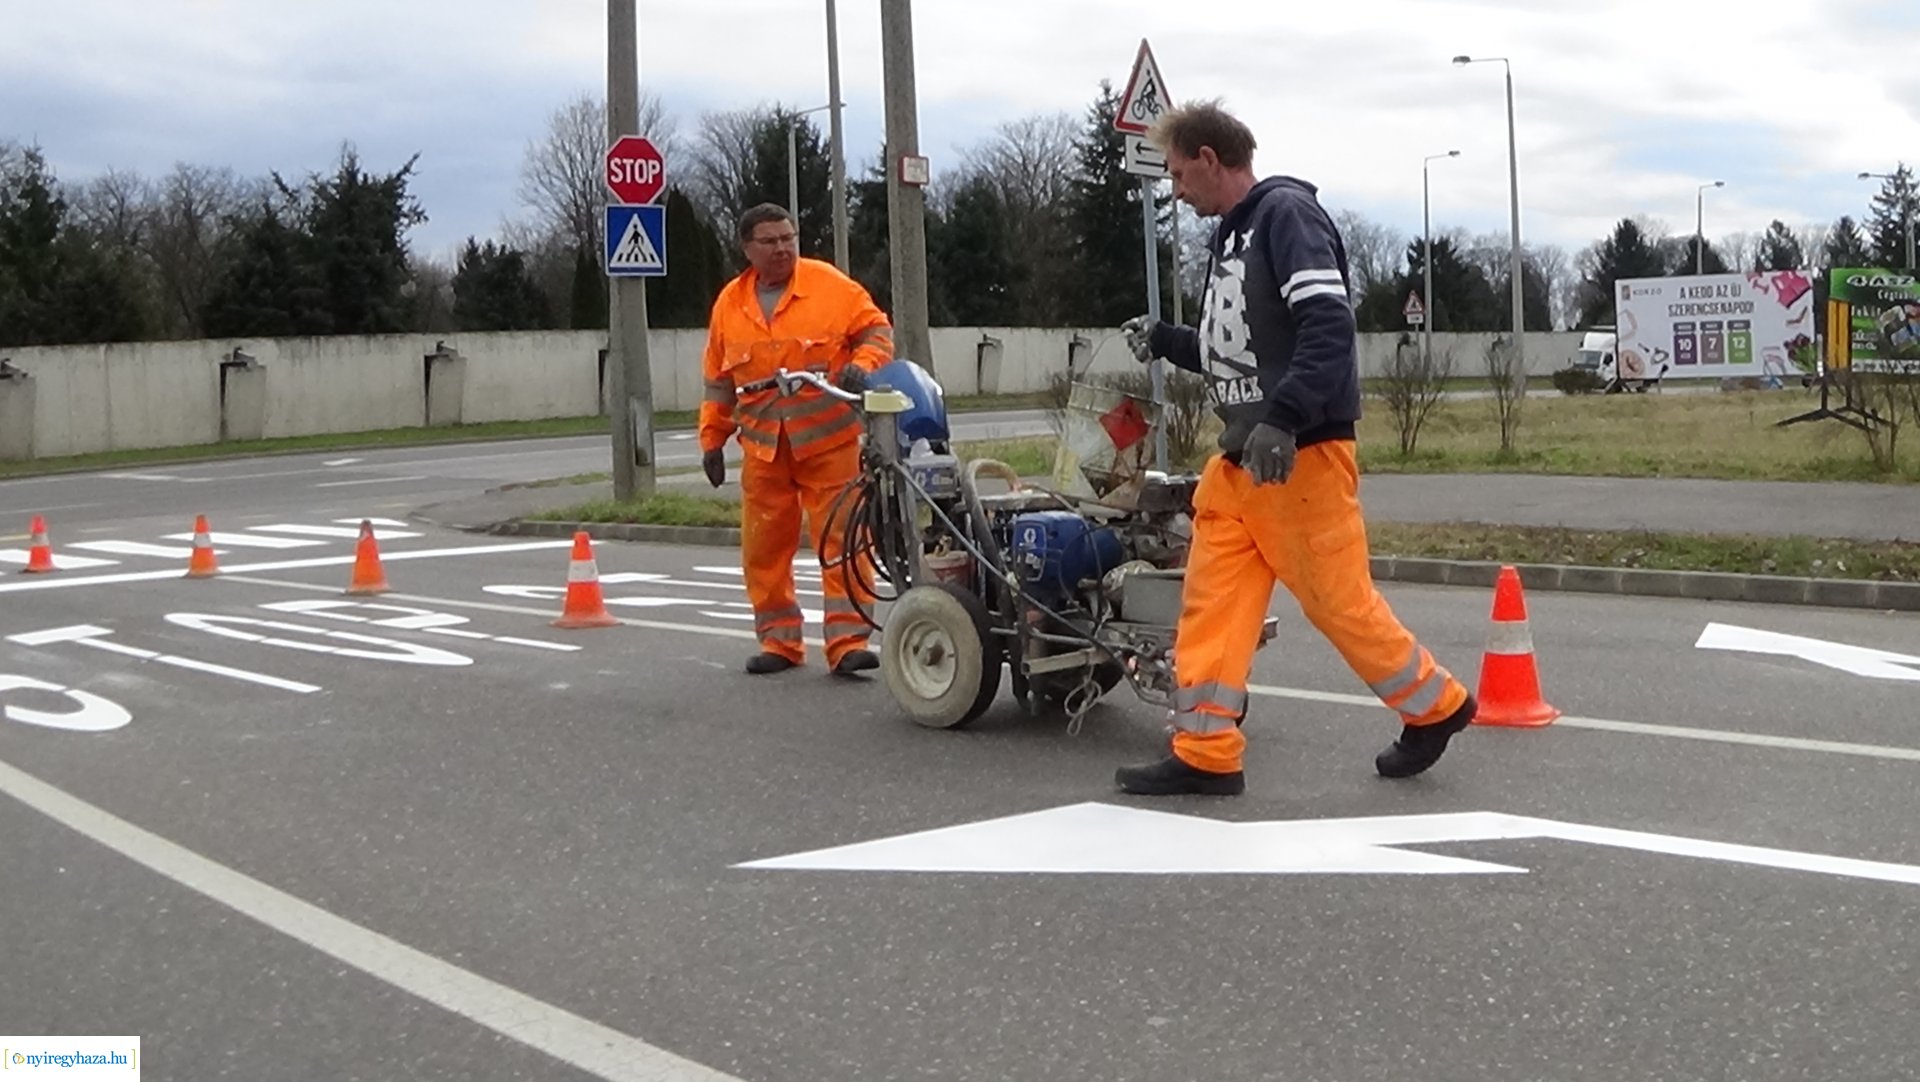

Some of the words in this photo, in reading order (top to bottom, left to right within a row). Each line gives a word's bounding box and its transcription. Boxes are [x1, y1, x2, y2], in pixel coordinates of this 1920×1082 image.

[610, 157, 661, 185] STOP
[1680, 286, 1686, 299] A
[1716, 284, 1729, 298] AZ
[1678, 338, 1692, 351] 10
[1708, 336, 1718, 350] 7
[1732, 336, 1746, 349] 12
